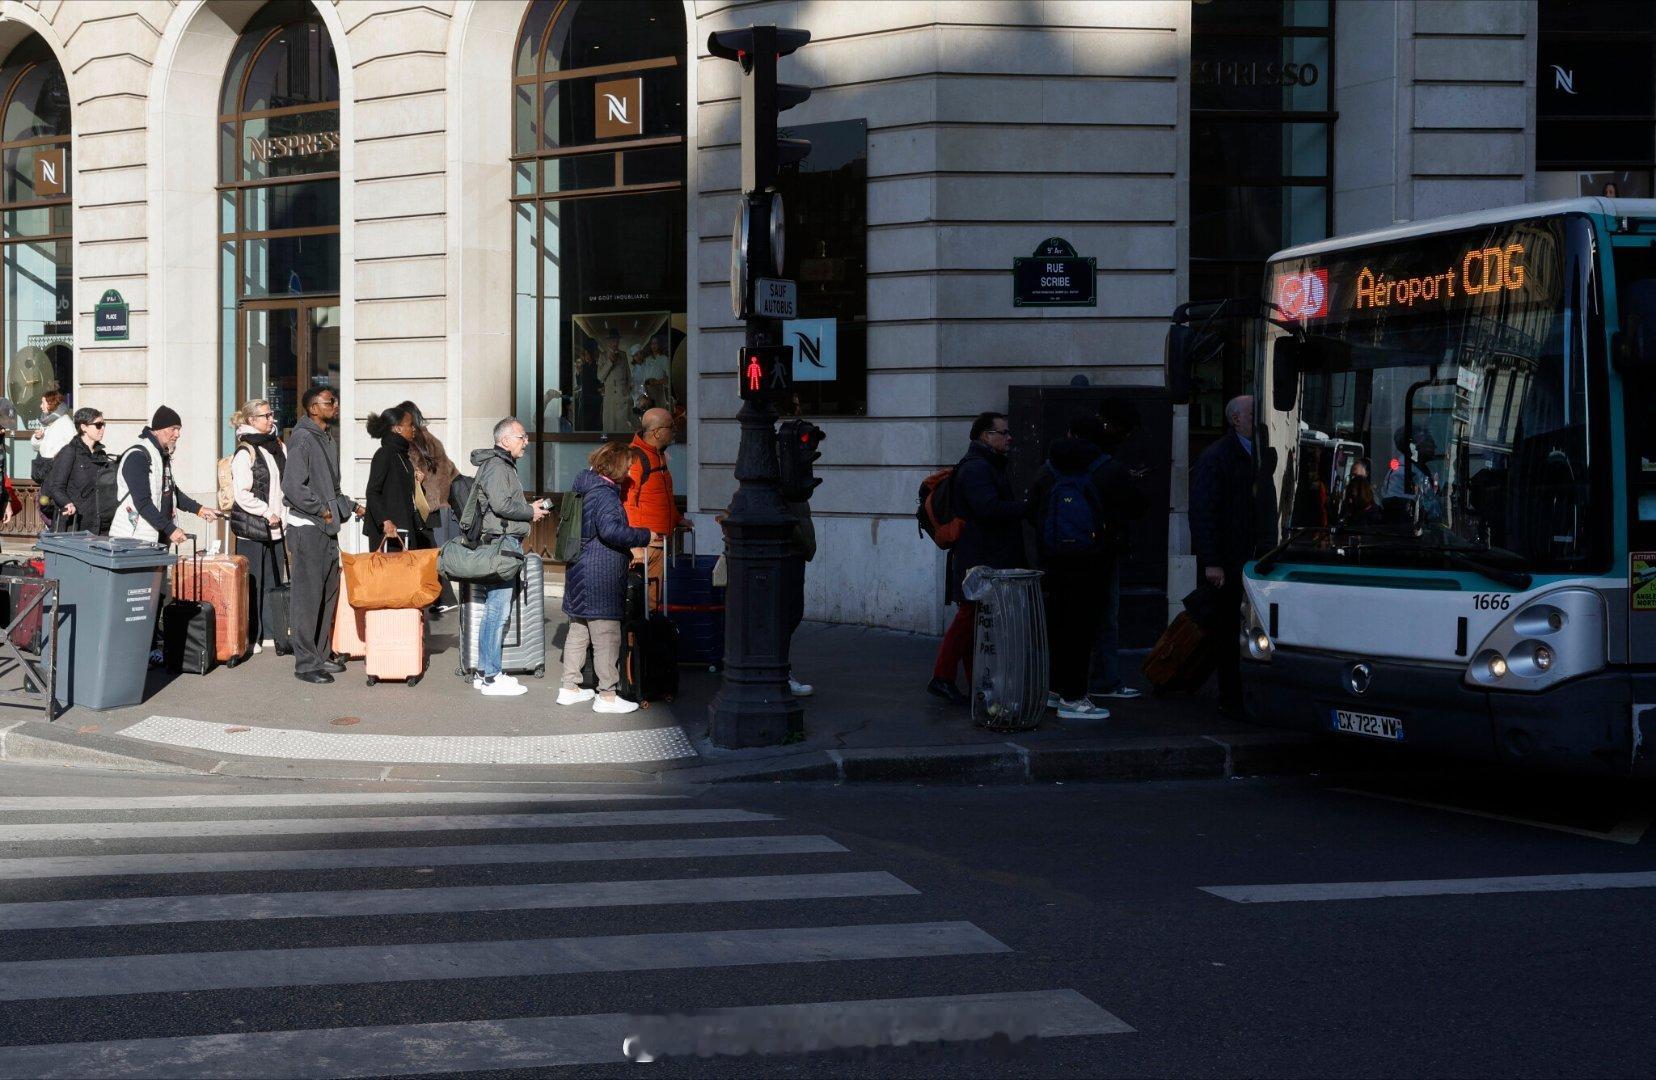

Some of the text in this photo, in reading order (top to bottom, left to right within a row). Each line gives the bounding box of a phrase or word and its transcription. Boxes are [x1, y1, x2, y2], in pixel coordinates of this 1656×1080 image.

[1550, 64, 1578, 95] N
[601, 93, 633, 125] N
[40, 159, 59, 185] N
[1046, 263, 1064, 273] RUE
[1356, 243, 1525, 309] Aéroport CDG
[769, 283, 787, 298] SAUF
[1040, 276, 1071, 287] SCRIBE
[763, 299, 793, 315] AUTOBUS
[792, 331, 829, 368] N
[1472, 594, 1511, 610] 1666
